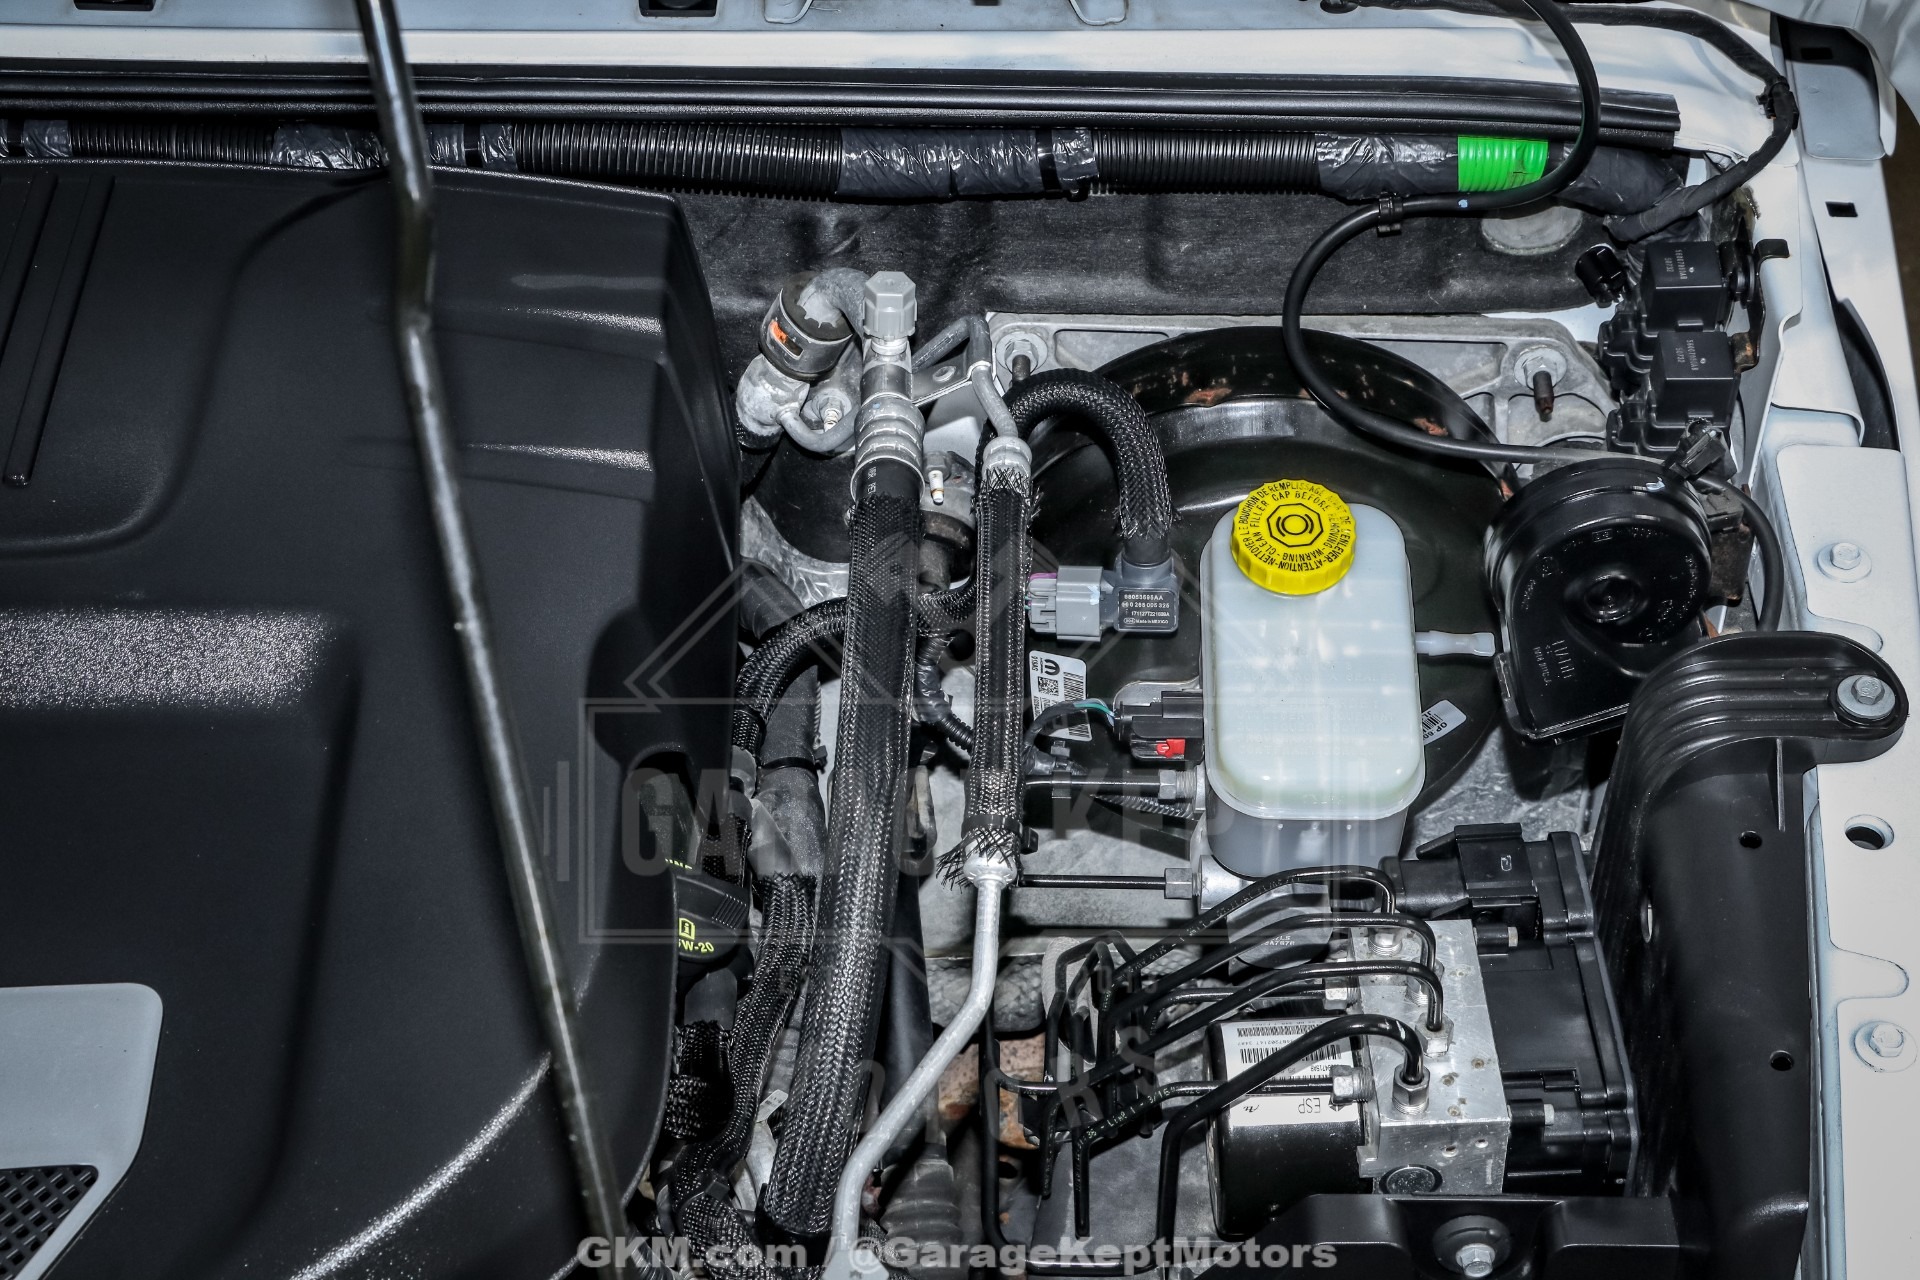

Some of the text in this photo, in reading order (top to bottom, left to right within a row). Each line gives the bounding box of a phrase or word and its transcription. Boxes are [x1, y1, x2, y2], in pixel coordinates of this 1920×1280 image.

[1257, 487, 1270, 500] DE
[1271, 491, 1291, 502] CAP
[1294, 491, 1330, 512] BEFORE
[1238, 495, 1260, 525] BOUCHON
[1249, 499, 1269, 528] FILLER
[1242, 537, 1275, 566] NETTOYER
[1253, 531, 1278, 556] CLEAN
[1298, 1097, 1321, 1114] ESP
